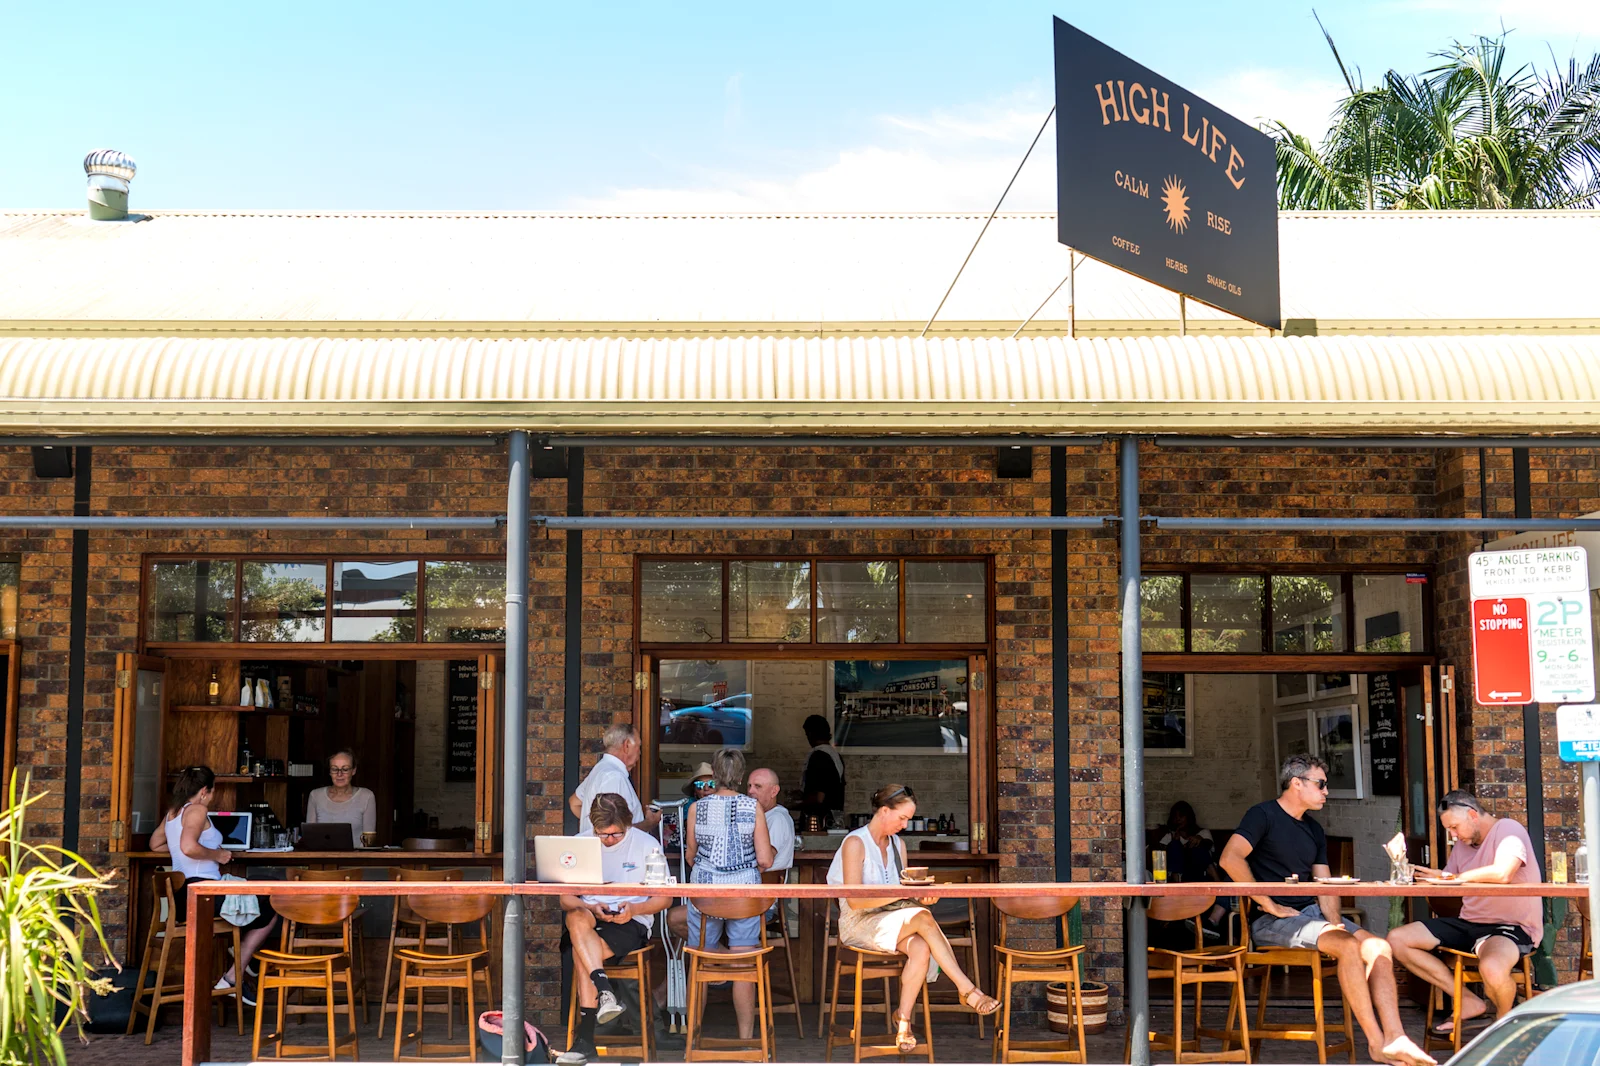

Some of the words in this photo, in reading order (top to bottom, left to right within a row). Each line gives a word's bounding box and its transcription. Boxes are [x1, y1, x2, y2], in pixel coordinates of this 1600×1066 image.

[1095, 80, 1171, 132] HIGH
[1182, 103, 1246, 190] LIFE
[1114, 170, 1150, 199] CALM
[1207, 211, 1232, 235] RISE
[1112, 235, 1141, 255] COFFEE
[1165, 257, 1189, 274] HERBS
[1206, 273, 1227, 290] SNAKE
[1227, 283, 1242, 297] OILS
[1498, 553, 1531, 565] ANGLE
[1537, 550, 1580, 563] PARKING
[1484, 567, 1516, 577] FRONT
[1524, 566, 1536, 575] TO
[1544, 564, 1572, 574] KERB
[1492, 603, 1508, 616] NO
[1537, 600, 1584, 626] 2P
[1479, 617, 1523, 631] STOPPING
[1540, 627, 1583, 638] METER
[1537, 638, 1587, 648] REGISTRATION
[1572, 741, 1600, 752] METE
[666, 877, 675, 885] 10
